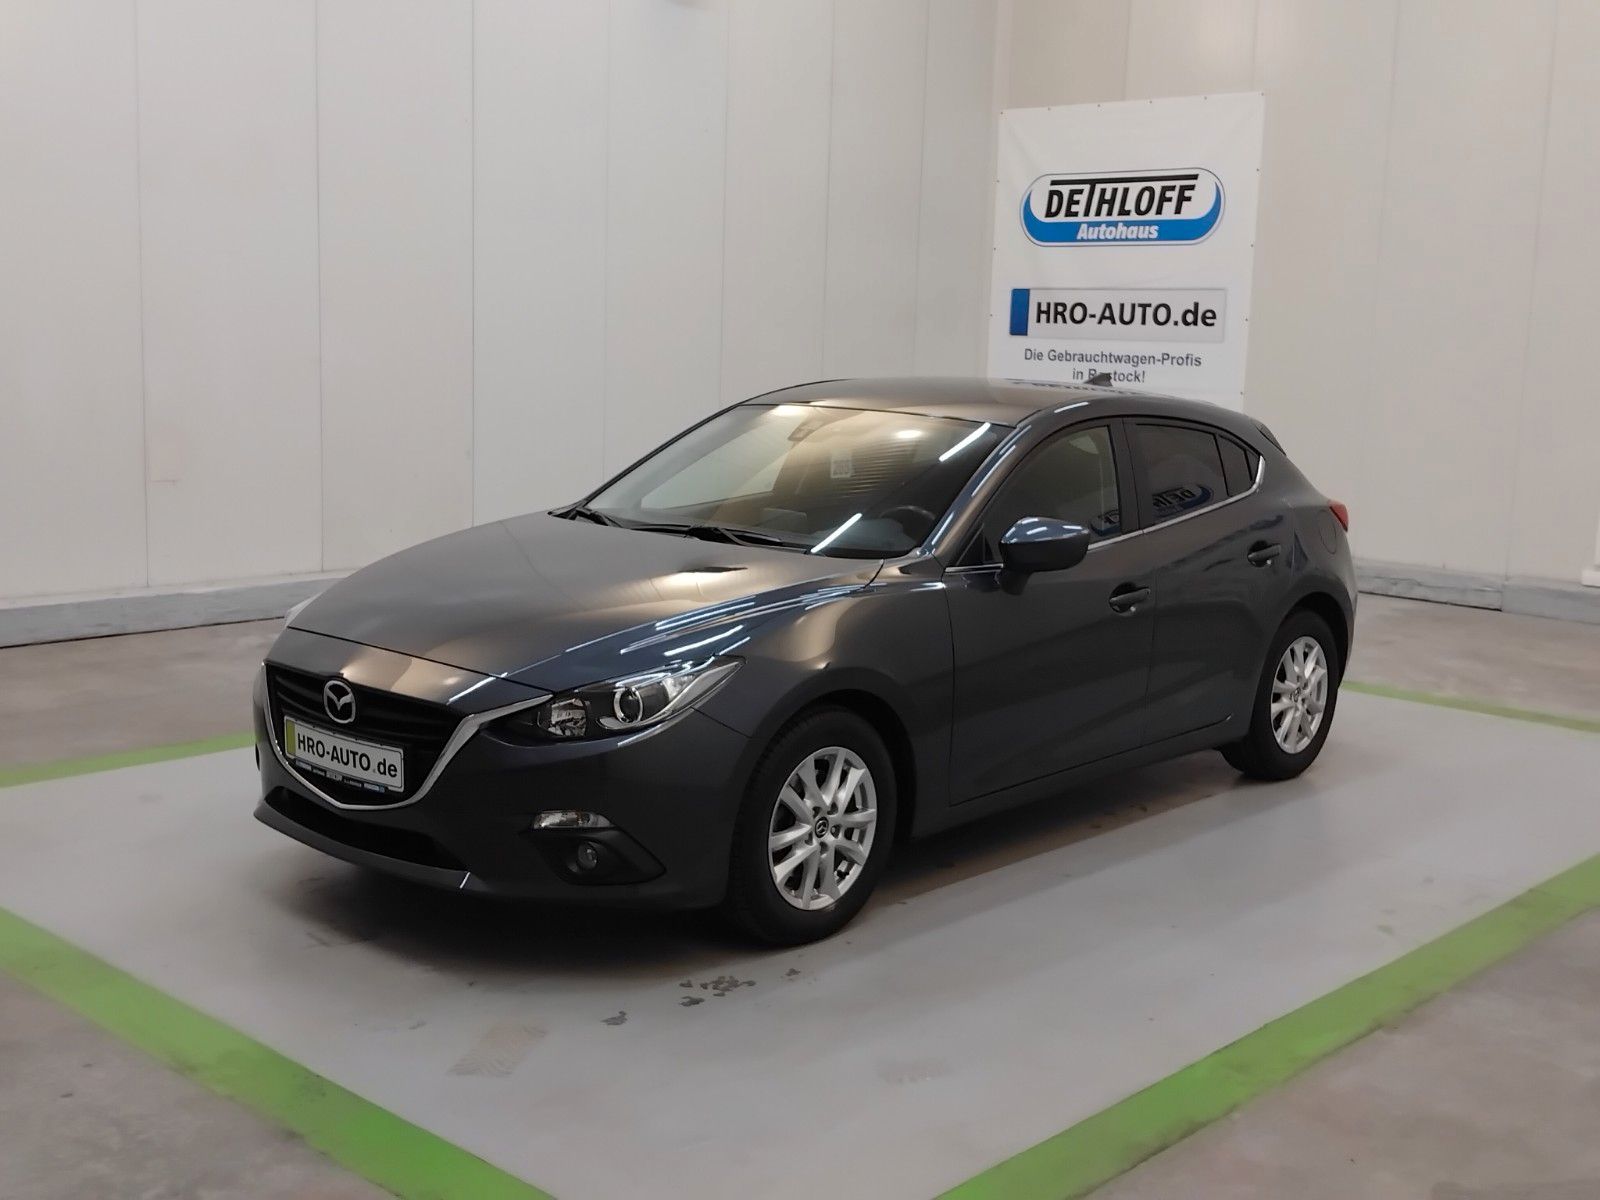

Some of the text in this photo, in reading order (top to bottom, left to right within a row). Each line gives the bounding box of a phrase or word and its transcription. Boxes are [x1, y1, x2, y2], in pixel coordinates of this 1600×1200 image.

[1045, 174, 1199, 218] DETHLOFF
[1077, 222, 1158, 240] Autohaus
[1035, 302, 1217, 327] HRO-AUTO.de
[1024, 349, 1202, 367] Die Gebrauchtwagen-Profis
[1073, 369, 1084, 381] in
